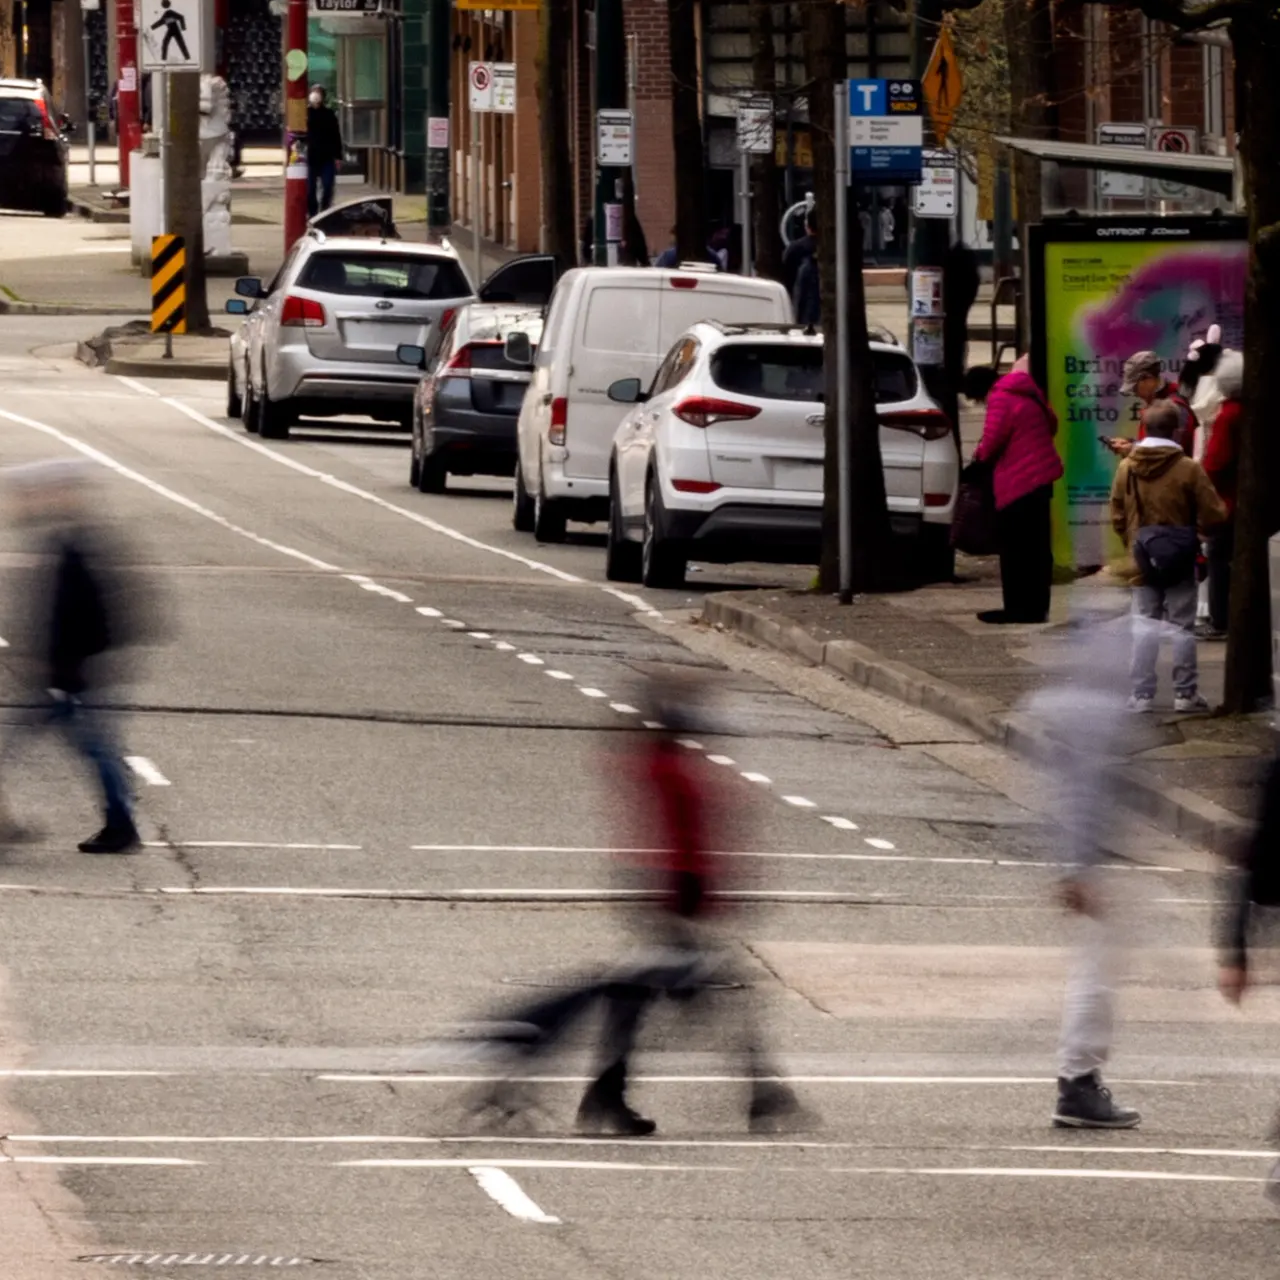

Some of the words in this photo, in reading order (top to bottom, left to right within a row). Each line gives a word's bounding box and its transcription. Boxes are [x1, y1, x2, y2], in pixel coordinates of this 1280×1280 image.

[1096, 228, 1146, 237] OUTFRONT
[1062, 273, 1107, 283] Creative
[1067, 404, 1118, 421] into
